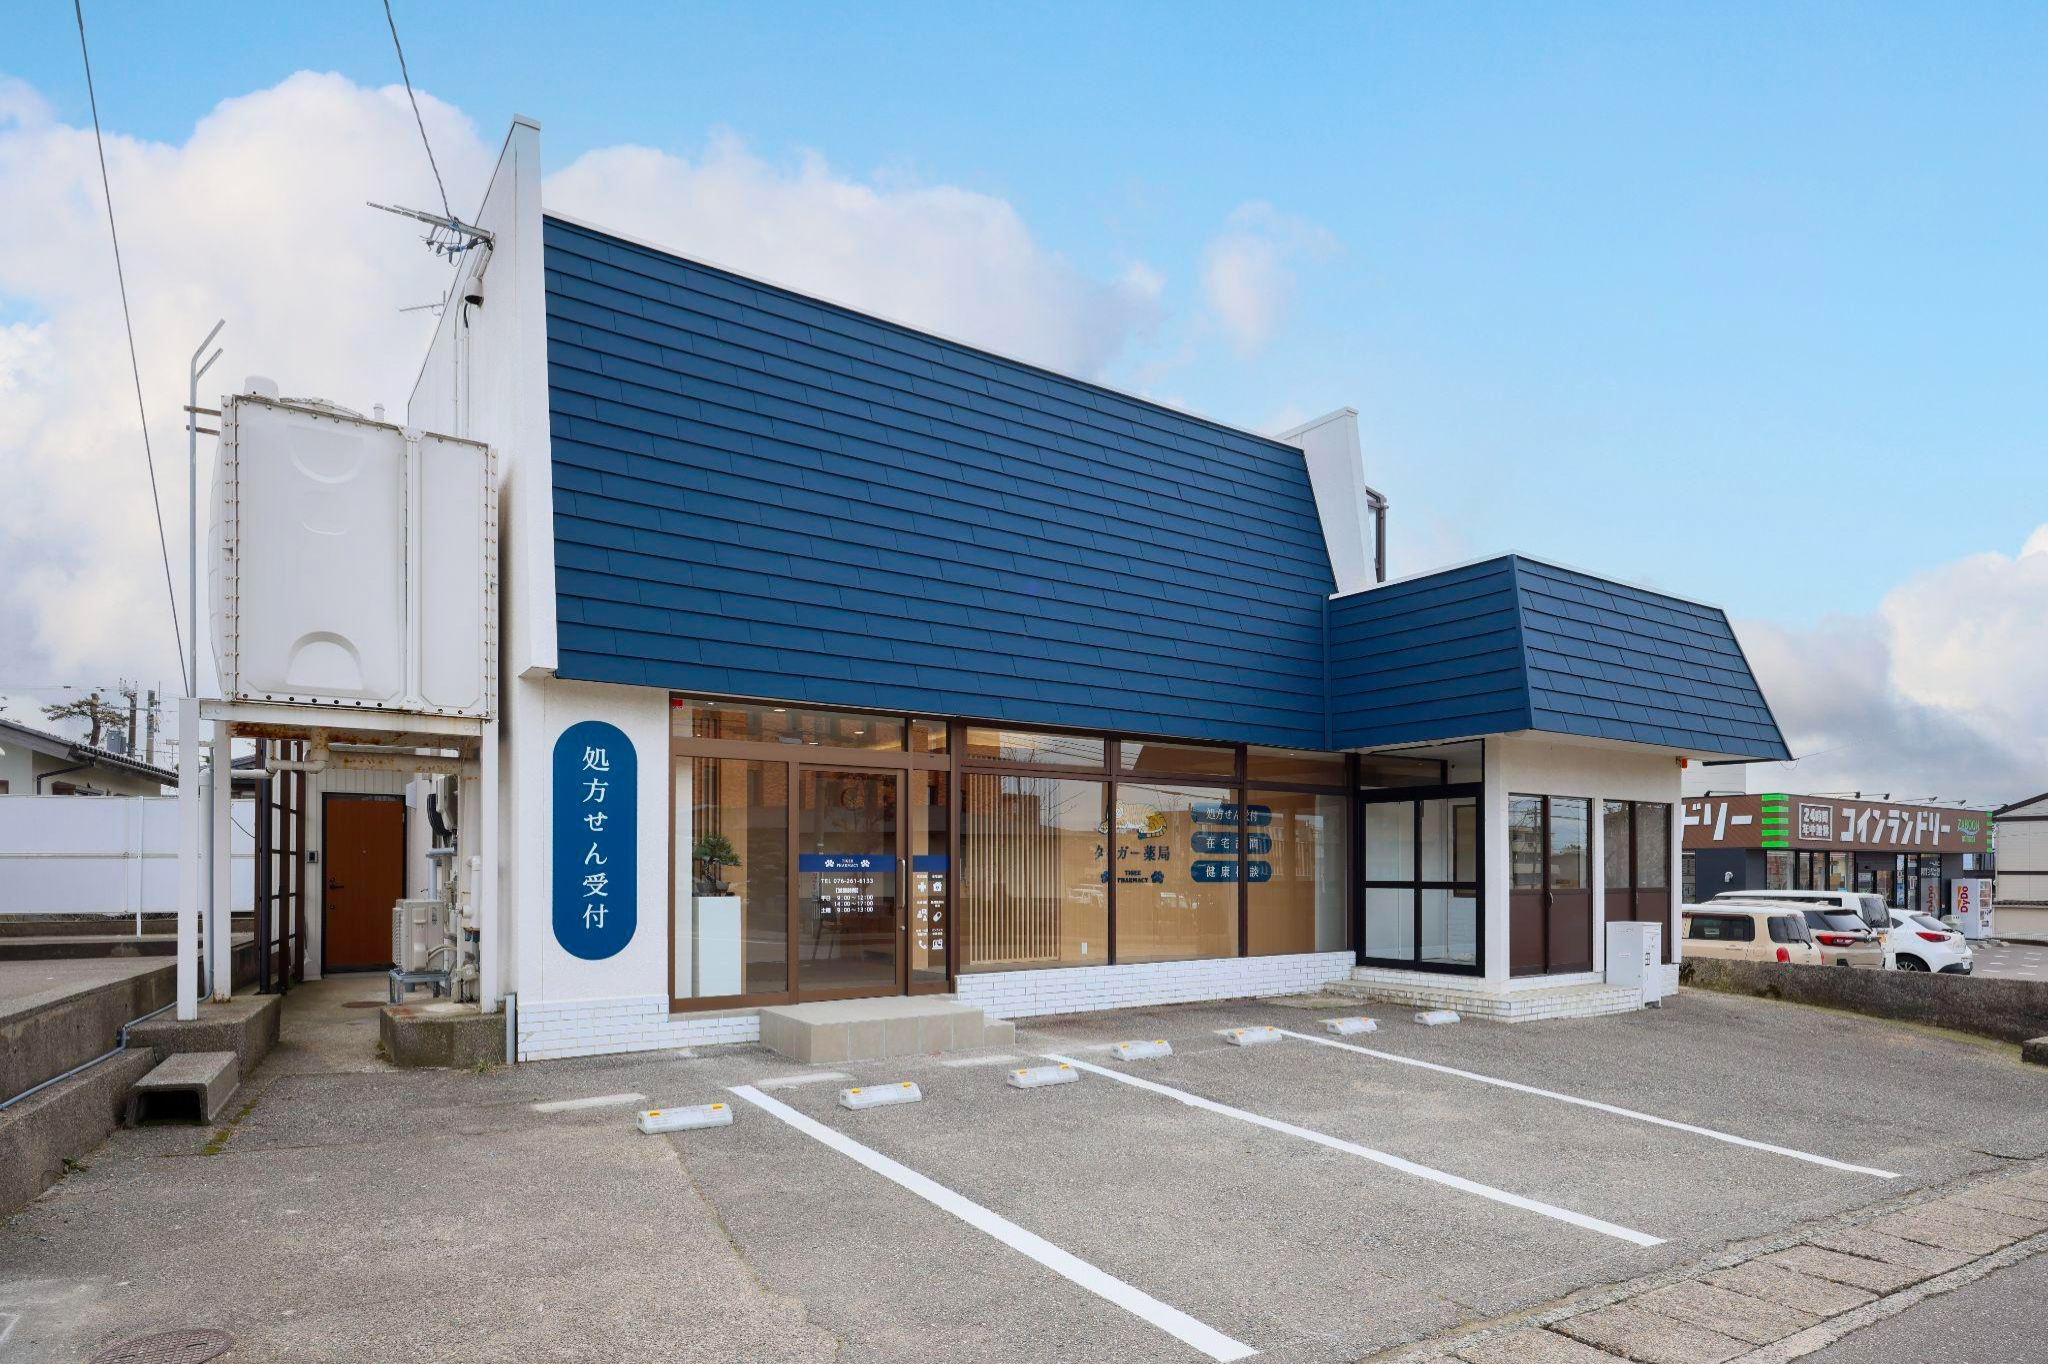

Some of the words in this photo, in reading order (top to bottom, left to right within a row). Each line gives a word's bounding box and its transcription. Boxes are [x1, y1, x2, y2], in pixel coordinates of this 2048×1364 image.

[1803, 807, 1829, 823] 24時間
[1839, 807, 1950, 846] コインランドリー
[582, 746, 610, 929] 処方せん受付
[1206, 836, 1259, 850] 在宅問
[1094, 844, 1171, 862] タガー薬局
[1206, 865, 1259, 878] 健康談
[1960, 885, 1971, 913] DyDo
